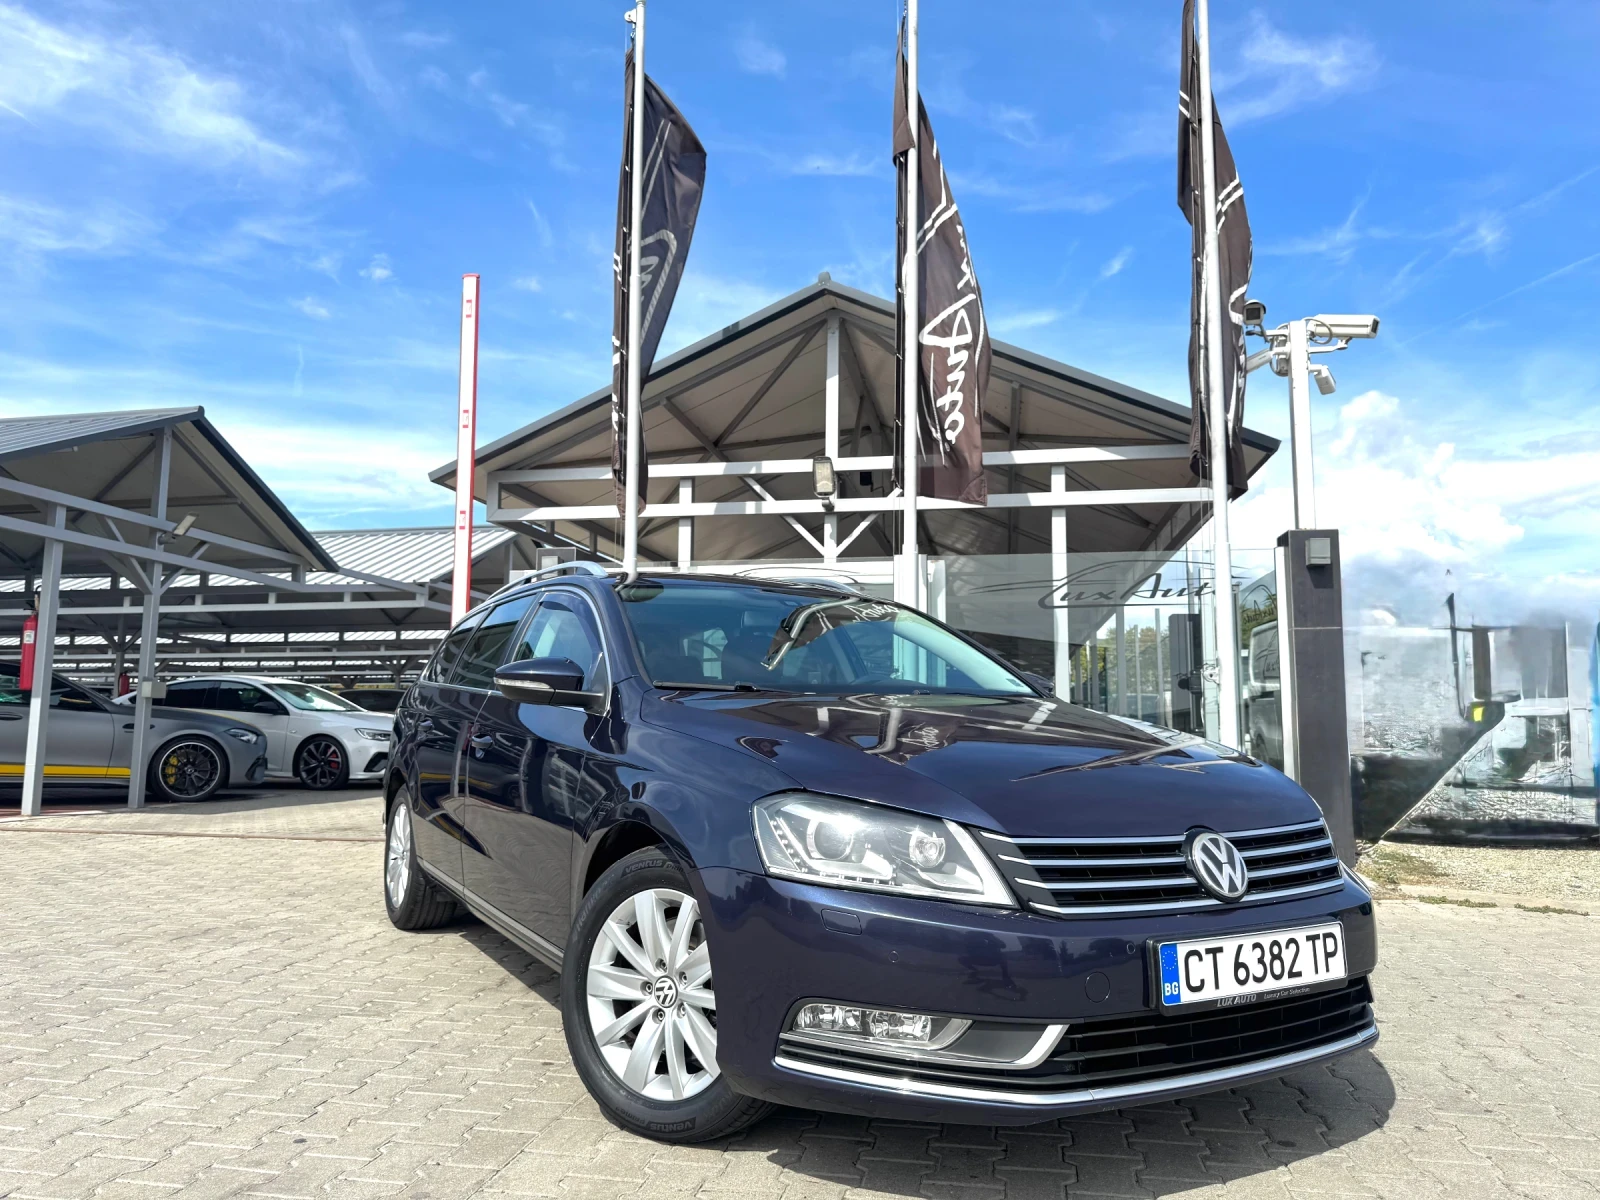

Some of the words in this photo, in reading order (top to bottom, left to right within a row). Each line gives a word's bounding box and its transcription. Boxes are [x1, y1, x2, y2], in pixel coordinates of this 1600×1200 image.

[1120, 572, 1216, 600] Aut
[1164, 982, 1179, 996] BG
[1184, 947, 1224, 993] CT
[1233, 937, 1302, 986] 6382
[1305, 931, 1338, 975] TP
[1216, 998, 1233, 1008] LUX
[1234, 993, 1257, 1005] AUTO
